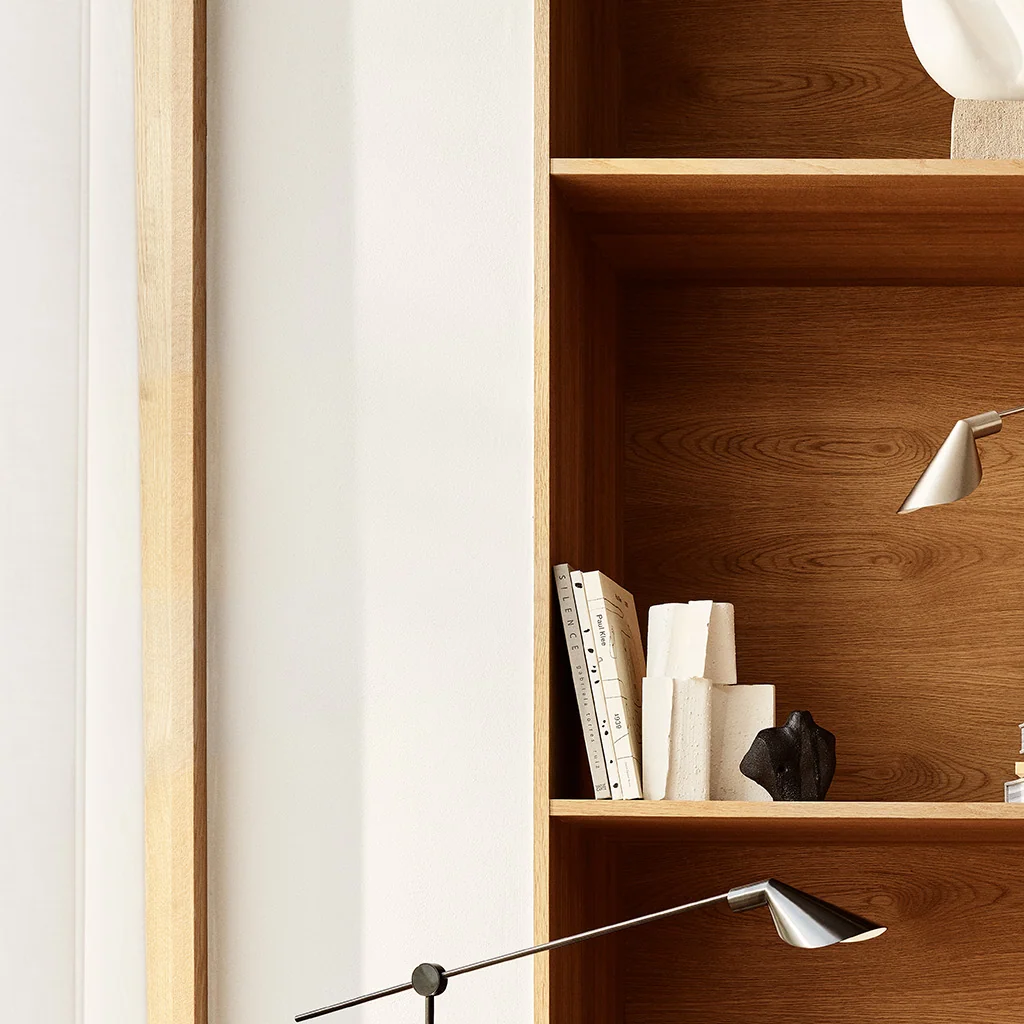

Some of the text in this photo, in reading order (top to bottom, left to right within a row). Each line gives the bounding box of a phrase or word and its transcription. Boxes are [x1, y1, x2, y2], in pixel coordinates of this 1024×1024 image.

[558, 574, 579, 652] SILENCE
[596, 614, 607, 647] Paul Klee
